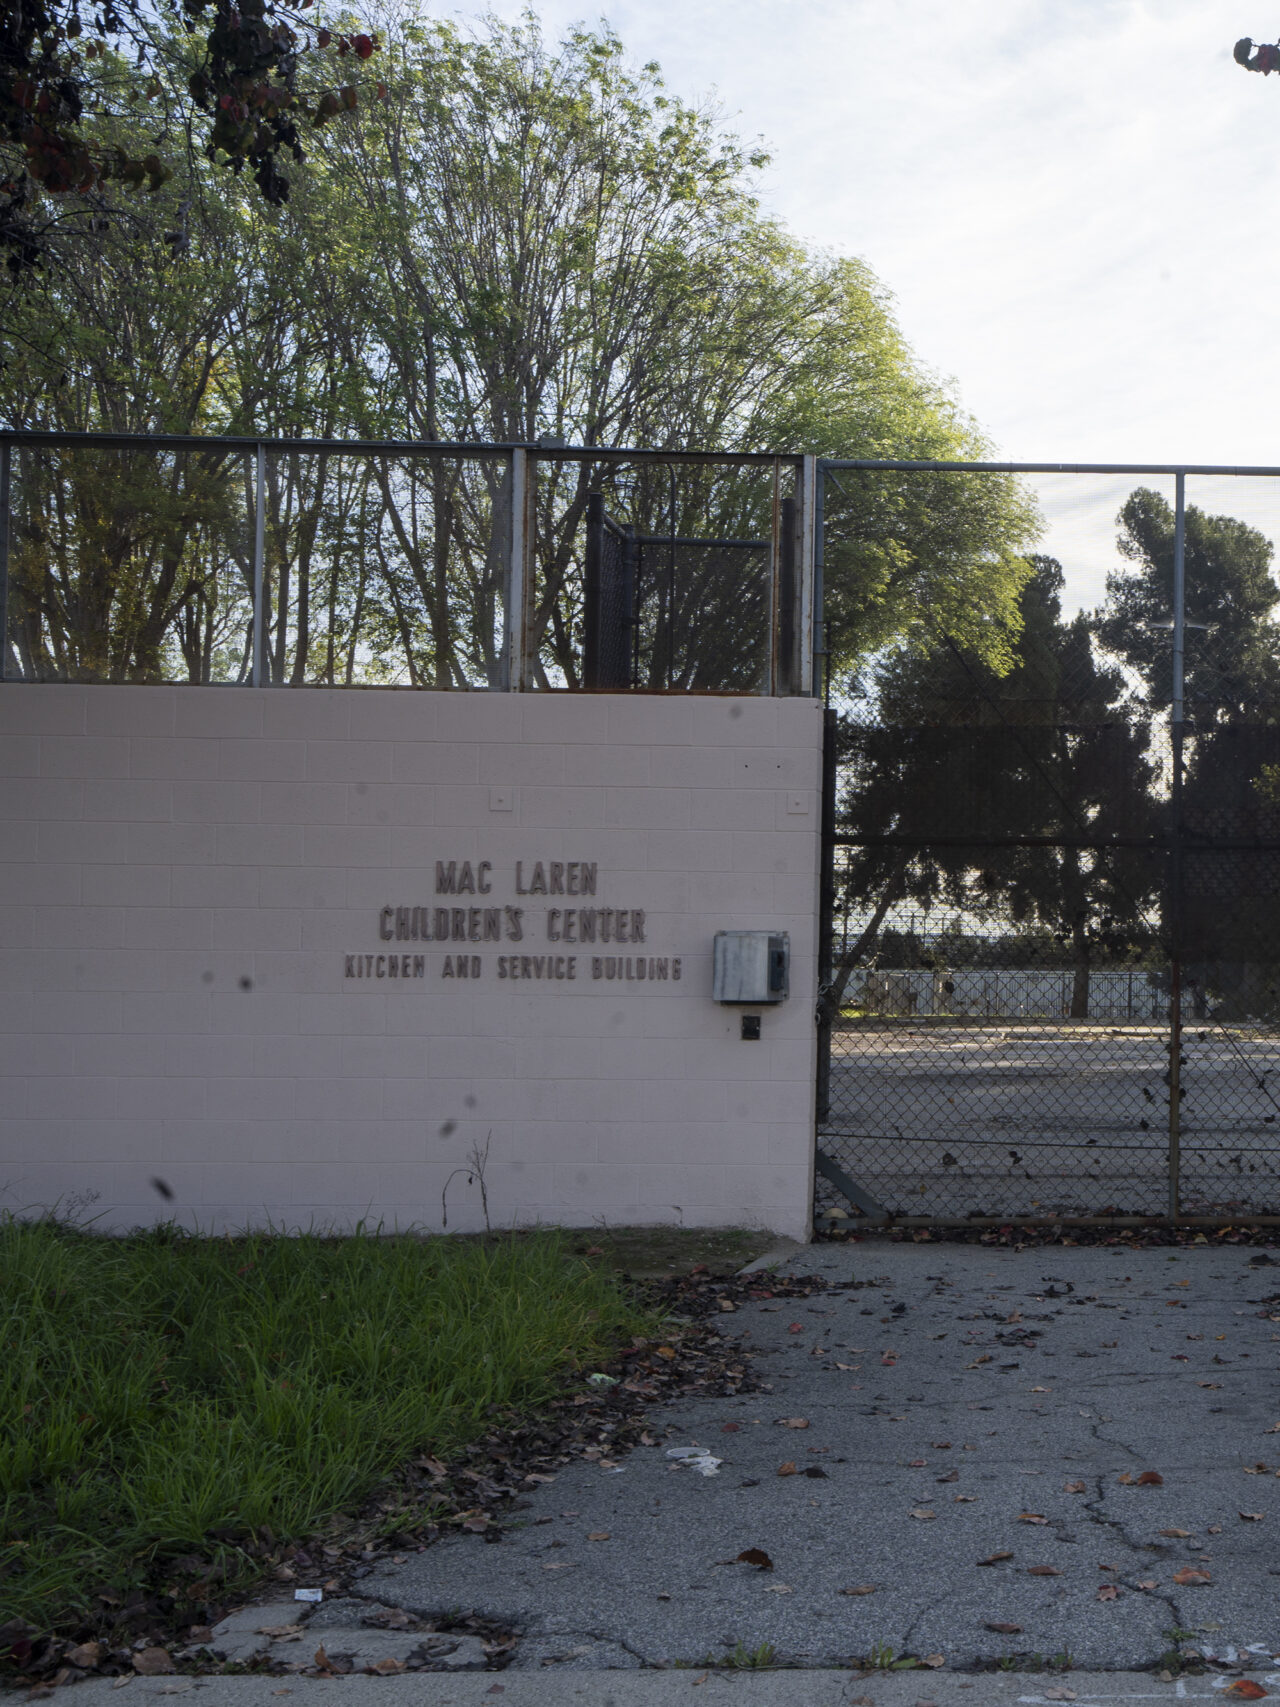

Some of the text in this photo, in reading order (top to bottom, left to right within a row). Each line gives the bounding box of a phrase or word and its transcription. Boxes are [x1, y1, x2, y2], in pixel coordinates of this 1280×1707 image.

[435, 860, 598, 896] MAC LAREN
[379, 905, 647, 943] CHILDREN'S CENTER
[344, 954, 682, 981] KITCHEN AND SERVICE BUILDING
